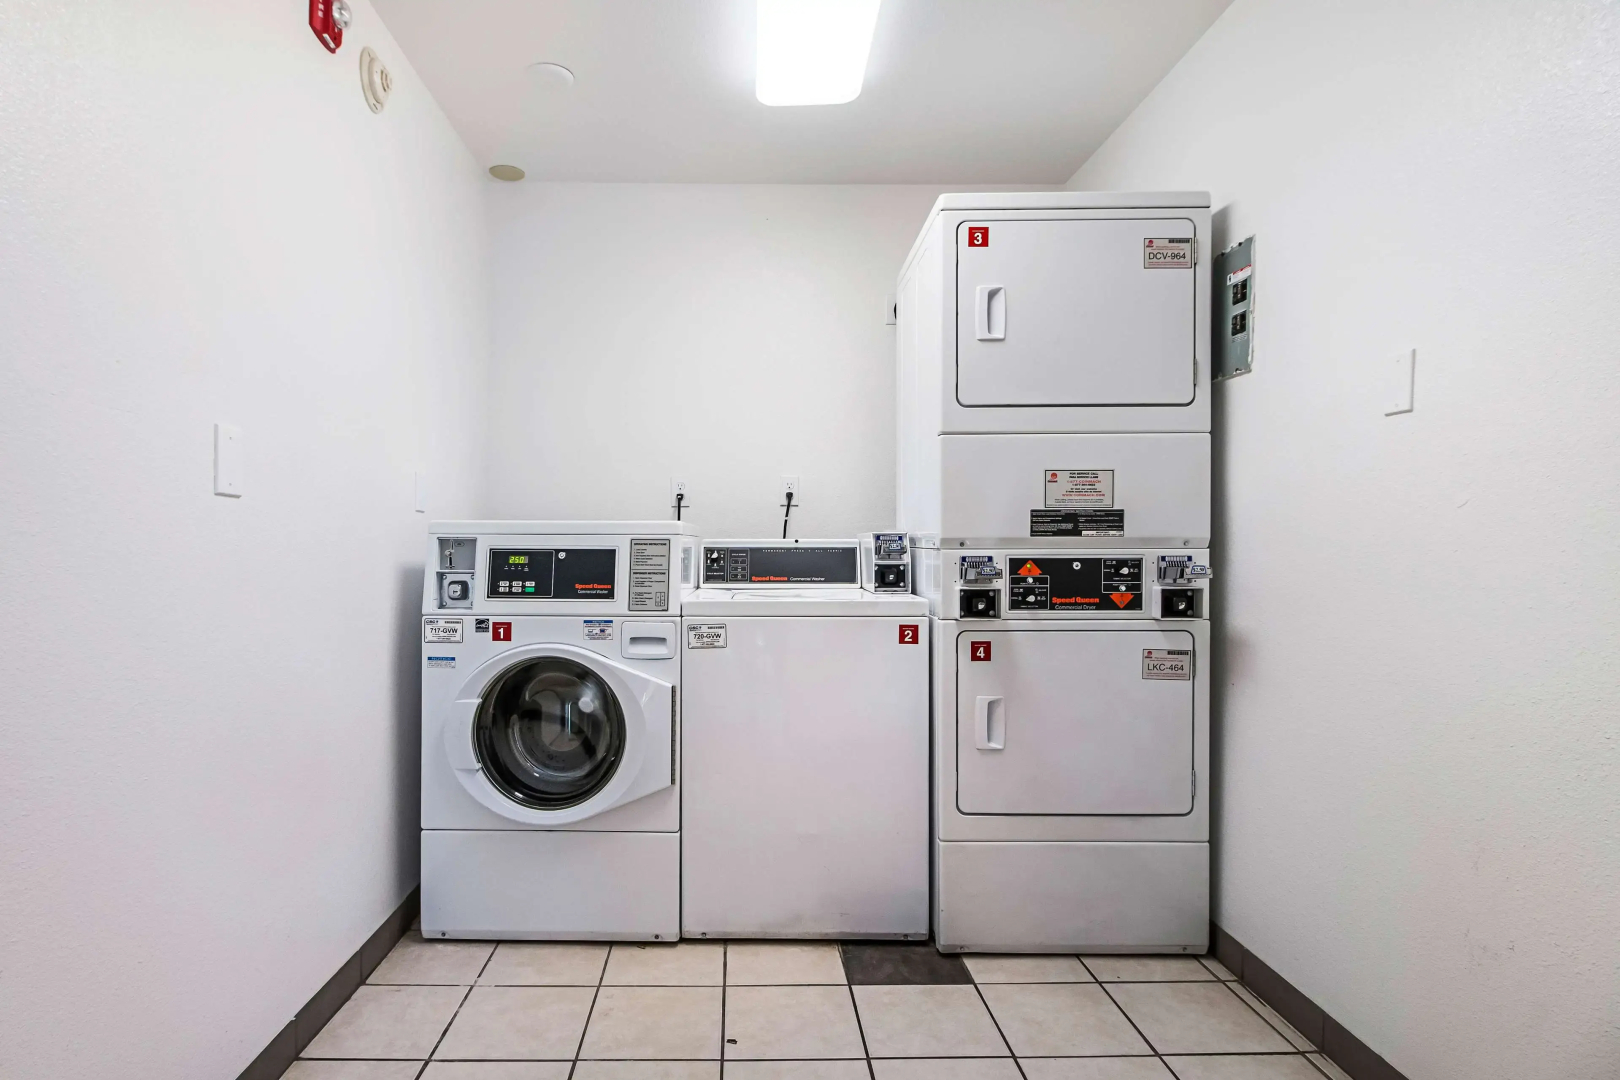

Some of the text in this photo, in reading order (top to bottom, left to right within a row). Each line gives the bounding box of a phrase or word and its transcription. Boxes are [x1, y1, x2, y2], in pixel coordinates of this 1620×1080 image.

[974, 232, 982, 244] 3
[1148, 252, 1186, 260] DCV-964
[498, 628, 503, 639] 1
[904, 630, 912, 641] 2
[977, 647, 985, 658] 4
[1148, 663, 1184, 671] LKC-464
